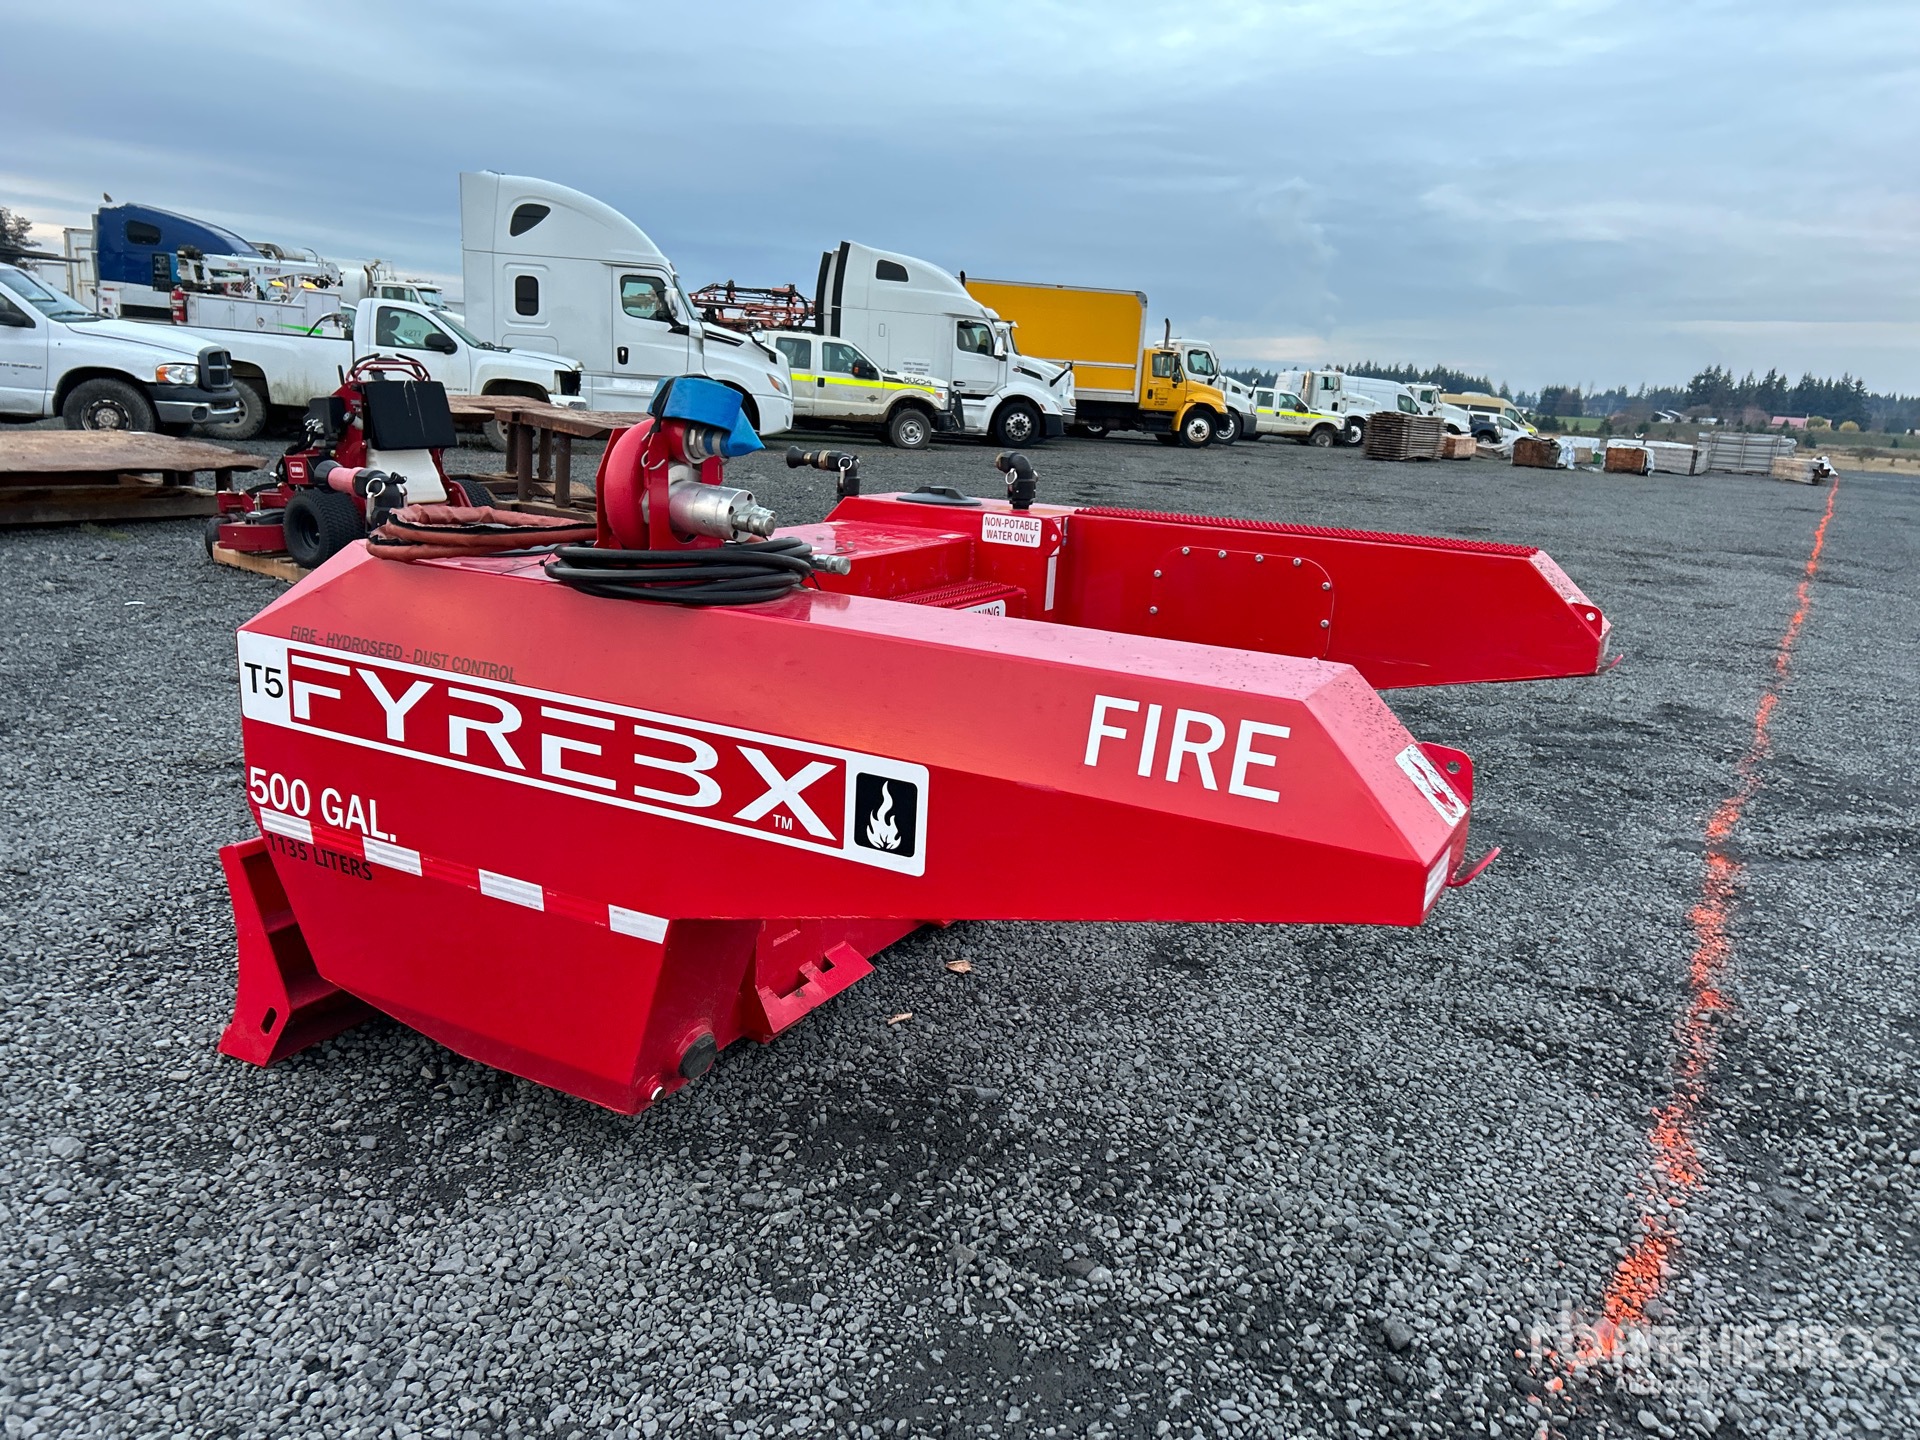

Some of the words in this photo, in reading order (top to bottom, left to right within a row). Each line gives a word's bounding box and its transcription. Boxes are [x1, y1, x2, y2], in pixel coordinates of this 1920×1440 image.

[984, 516, 1040, 532] NON-POTABLE
[986, 529, 1012, 542] WATER
[1013, 532, 1035, 544] ONLY
[290, 625, 317, 643] FIRE
[326, 633, 403, 661] HYDROSEED
[414, 648, 449, 668] DUST
[452, 656, 517, 683] CONTROL
[244, 662, 284, 698] T5
[1084, 694, 1291, 803] FIRE
[249, 766, 311, 817] 500
[320, 787, 397, 843] GAL.
[267, 833, 309, 861] 1135
[312, 846, 373, 881] LITERS
